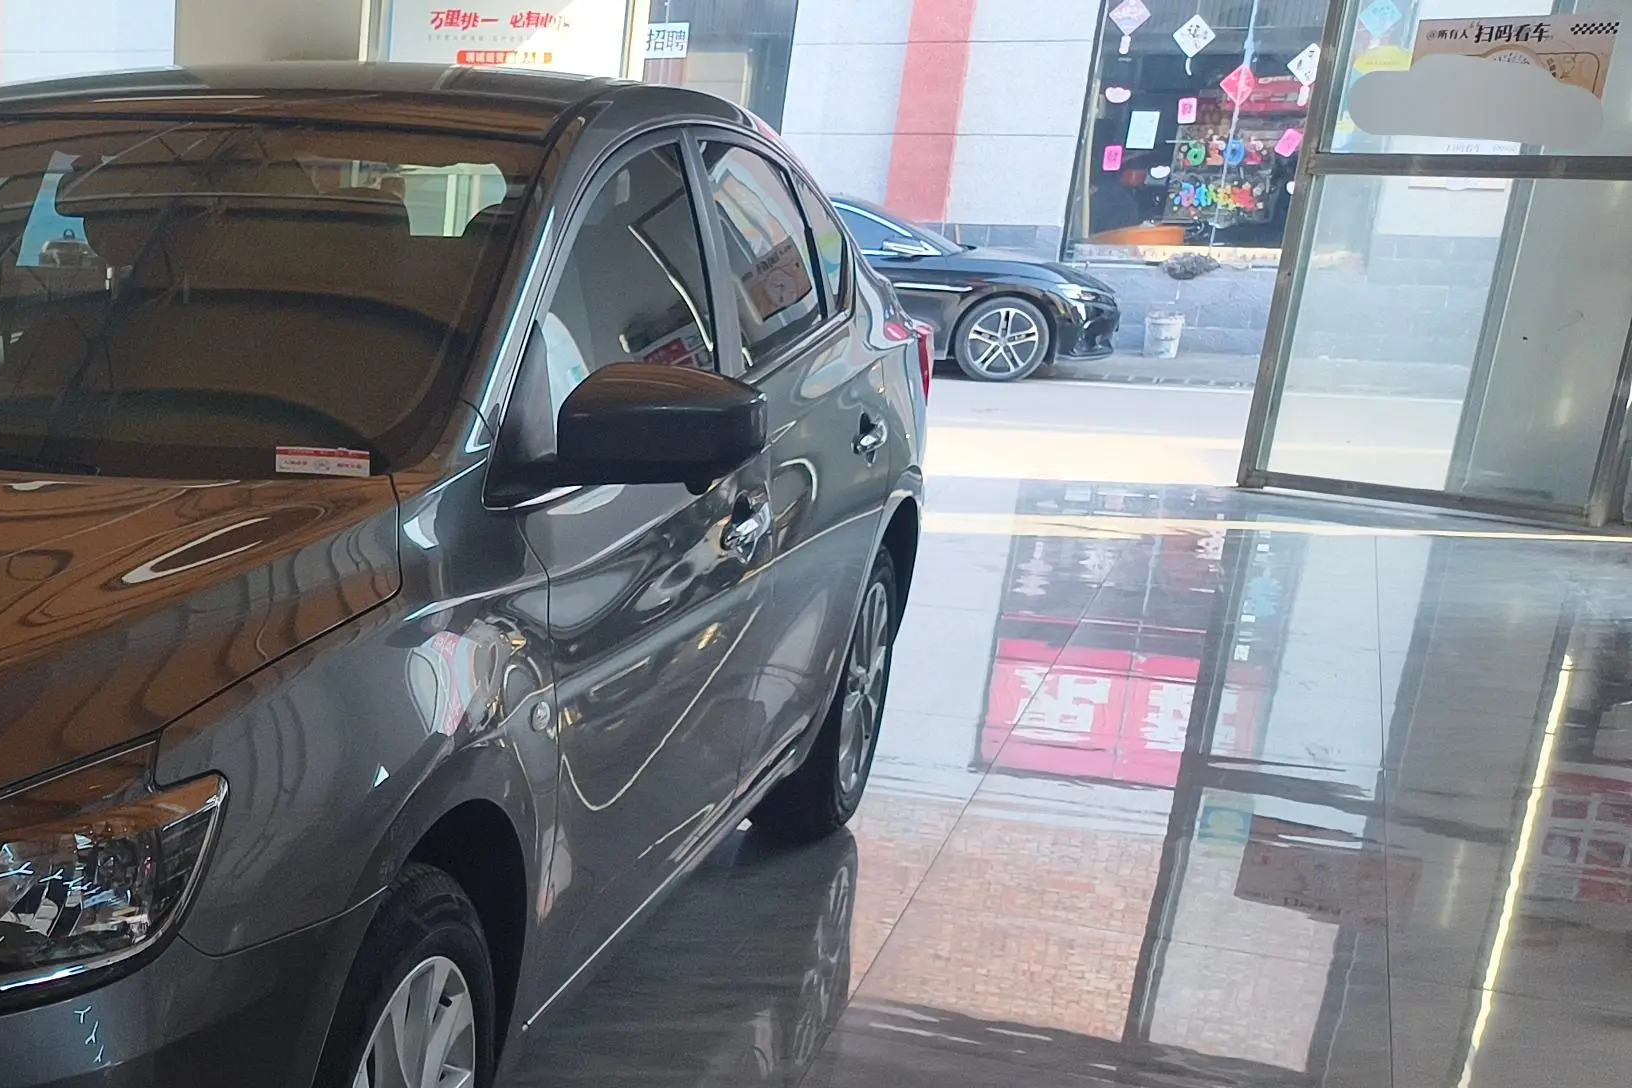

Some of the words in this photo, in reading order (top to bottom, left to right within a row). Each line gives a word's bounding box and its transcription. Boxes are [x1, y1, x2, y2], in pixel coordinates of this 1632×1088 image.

[430, 10, 499, 30] 万里挑一
[646, 29, 686, 51] 招聘
